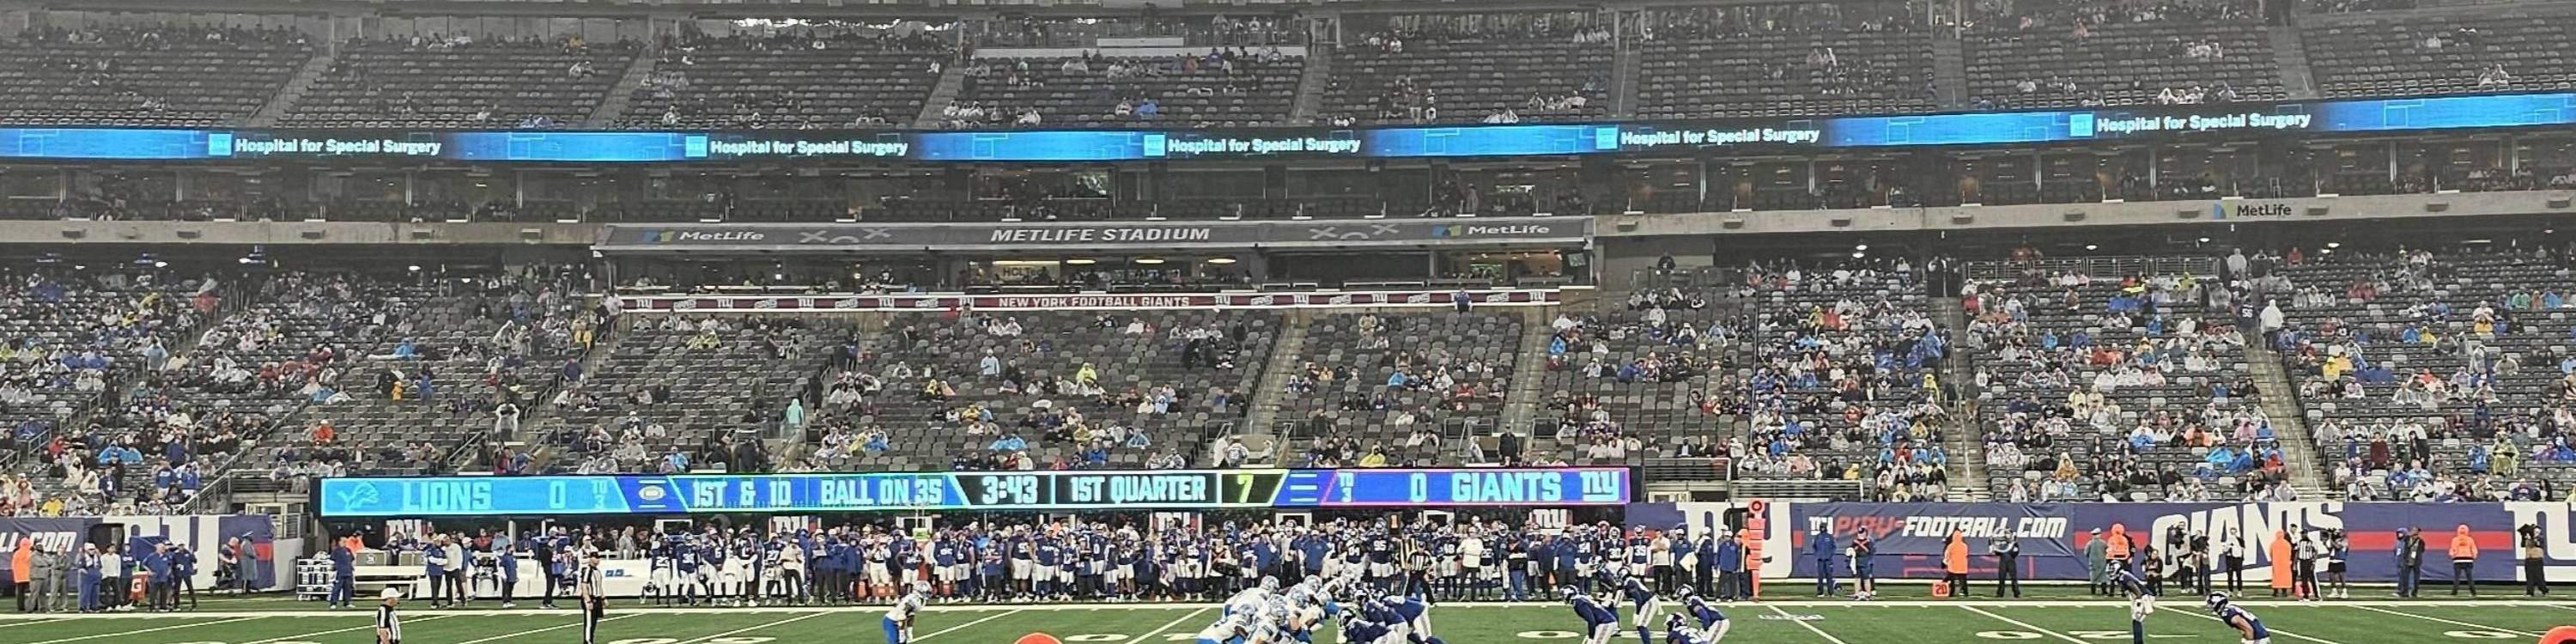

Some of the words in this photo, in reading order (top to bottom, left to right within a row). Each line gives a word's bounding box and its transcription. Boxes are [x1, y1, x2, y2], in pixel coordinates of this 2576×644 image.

[2097, 117, 2160, 134] Hospital
[2164, 116, 2186, 130] for
[2190, 114, 2245, 131] Special
[2249, 113, 2311, 129] Surgery
[1168, 138, 1226, 155] Hospital
[1228, 138, 1250, 152] for
[1252, 137, 1303, 154] Special
[1306, 137, 1361, 153] Surgery
[1621, 131, 1680, 146] Hospital
[1683, 130, 1704, 144] for
[1707, 129, 1759, 145] Special
[1762, 128, 1820, 143] Surgery
[235, 139, 298, 155] Hospital
[301, 139, 321, 152] for
[325, 139, 380, 155] Special
[383, 139, 441, 155] Surgery
[710, 141, 770, 156] Hospital
[773, 140, 795, 154] for
[796, 140, 849, 155] Special
[851, 140, 908, 155] Surgery
[2237, 204, 2292, 216] MetLife
[679, 231, 764, 241] MetLife
[990, 228, 1095, 241] METLIFE
[1102, 228, 1210, 241] STADIUM
[1468, 225, 1550, 235] MetLife
[999, 297, 1030, 307] NEW
[1033, 297, 1067, 307] YORK
[1072, 296, 1136, 307] FOOTBALL
[1141, 296, 1189, 307] GIANTS
[550, 480, 566, 509] 0
[693, 481, 727, 508] 1ST
[740, 481, 756, 507] &
[769, 481, 791, 507] 10
[821, 479, 874, 506] BALL
[879, 479, 908, 505] ON
[915, 479, 943, 505] 35
[981, 475, 1038, 505] 3:43
[1071, 477, 1105, 501] 1ST
[1110, 476, 1206, 504] QUARTER
[1237, 474, 1254, 504] 7
[1342, 488, 1352, 501] 3
[1410, 472, 1427, 501] 0
[1452, 472, 1561, 501] GIANTS
[402, 481, 493, 512] LIONS
[594, 495, 605, 508] 3
